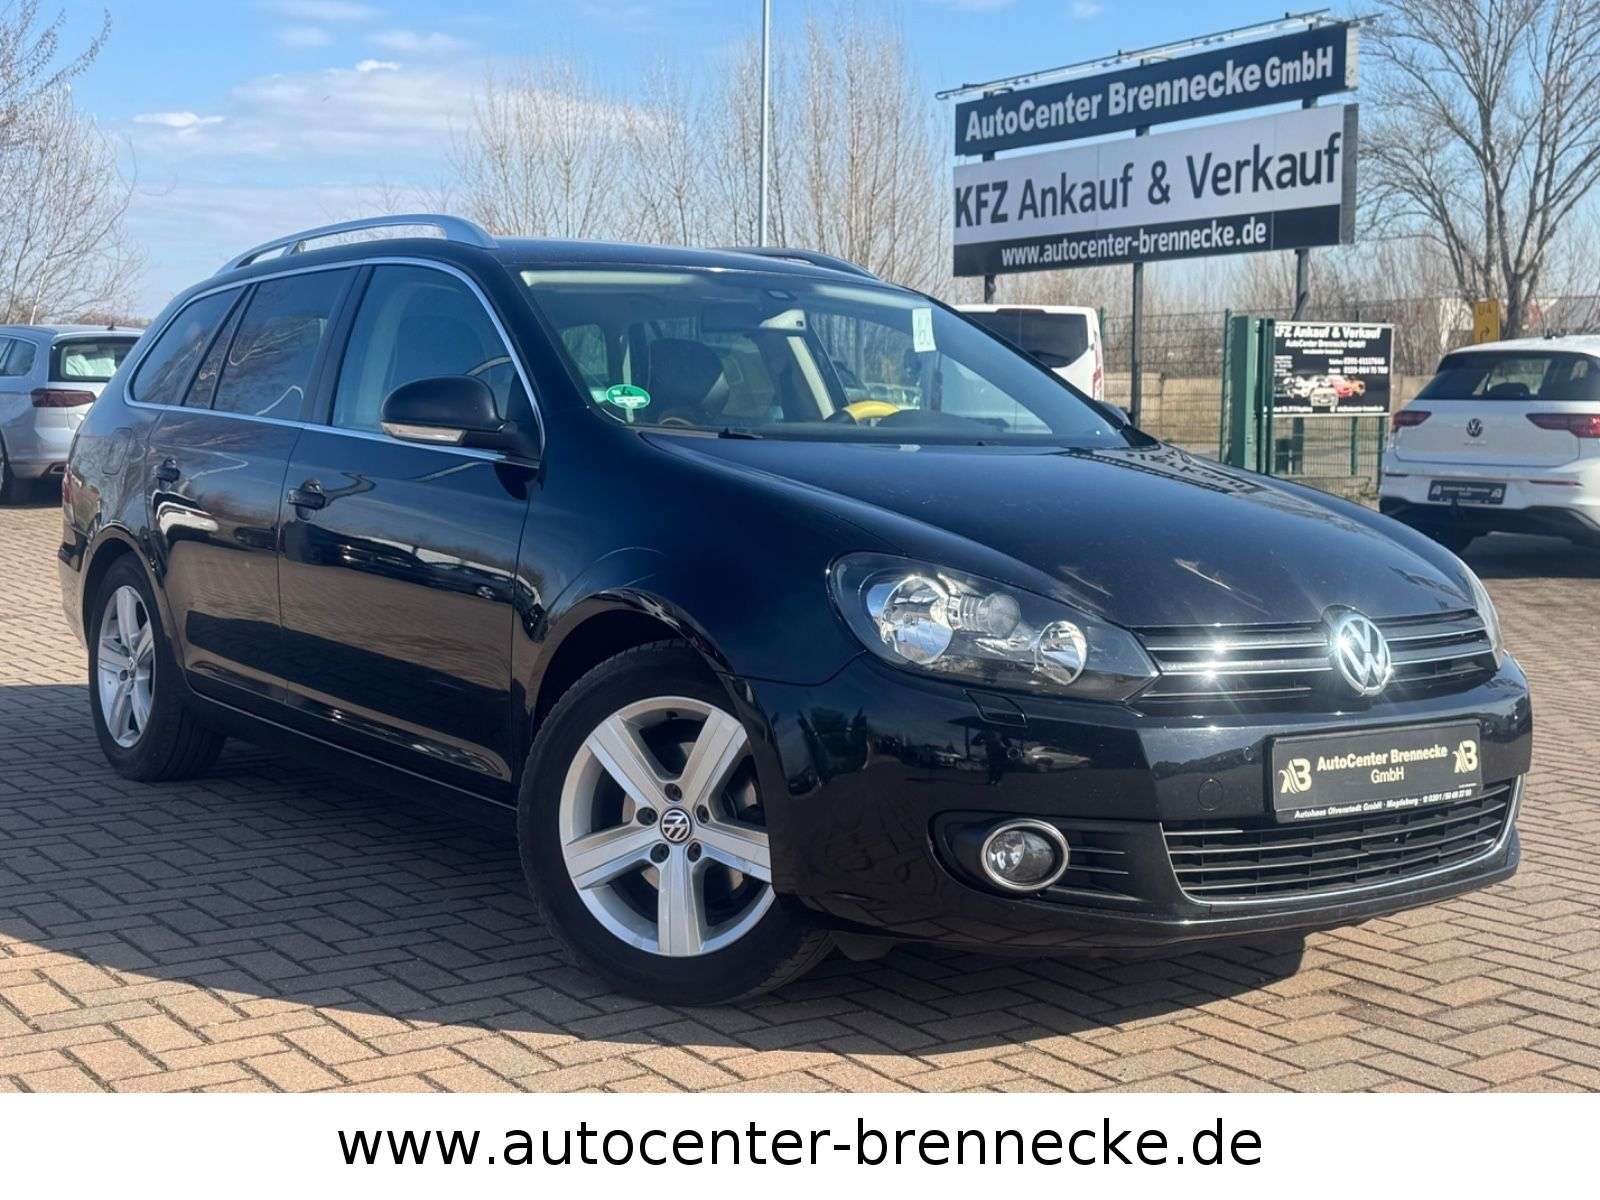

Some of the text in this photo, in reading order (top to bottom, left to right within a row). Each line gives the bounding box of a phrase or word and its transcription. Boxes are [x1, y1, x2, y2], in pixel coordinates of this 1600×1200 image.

[965, 46, 1334, 142] AutoCenter Brennecke GmbH
[955, 131, 1341, 228] KFZ Ankauf & Verkauf
[1001, 216, 1267, 267] www.autocenter-brennecke.de
[1316, 745, 1448, 772] AutoCenter Brennecke
[1370, 767, 1405, 784] GmbH
